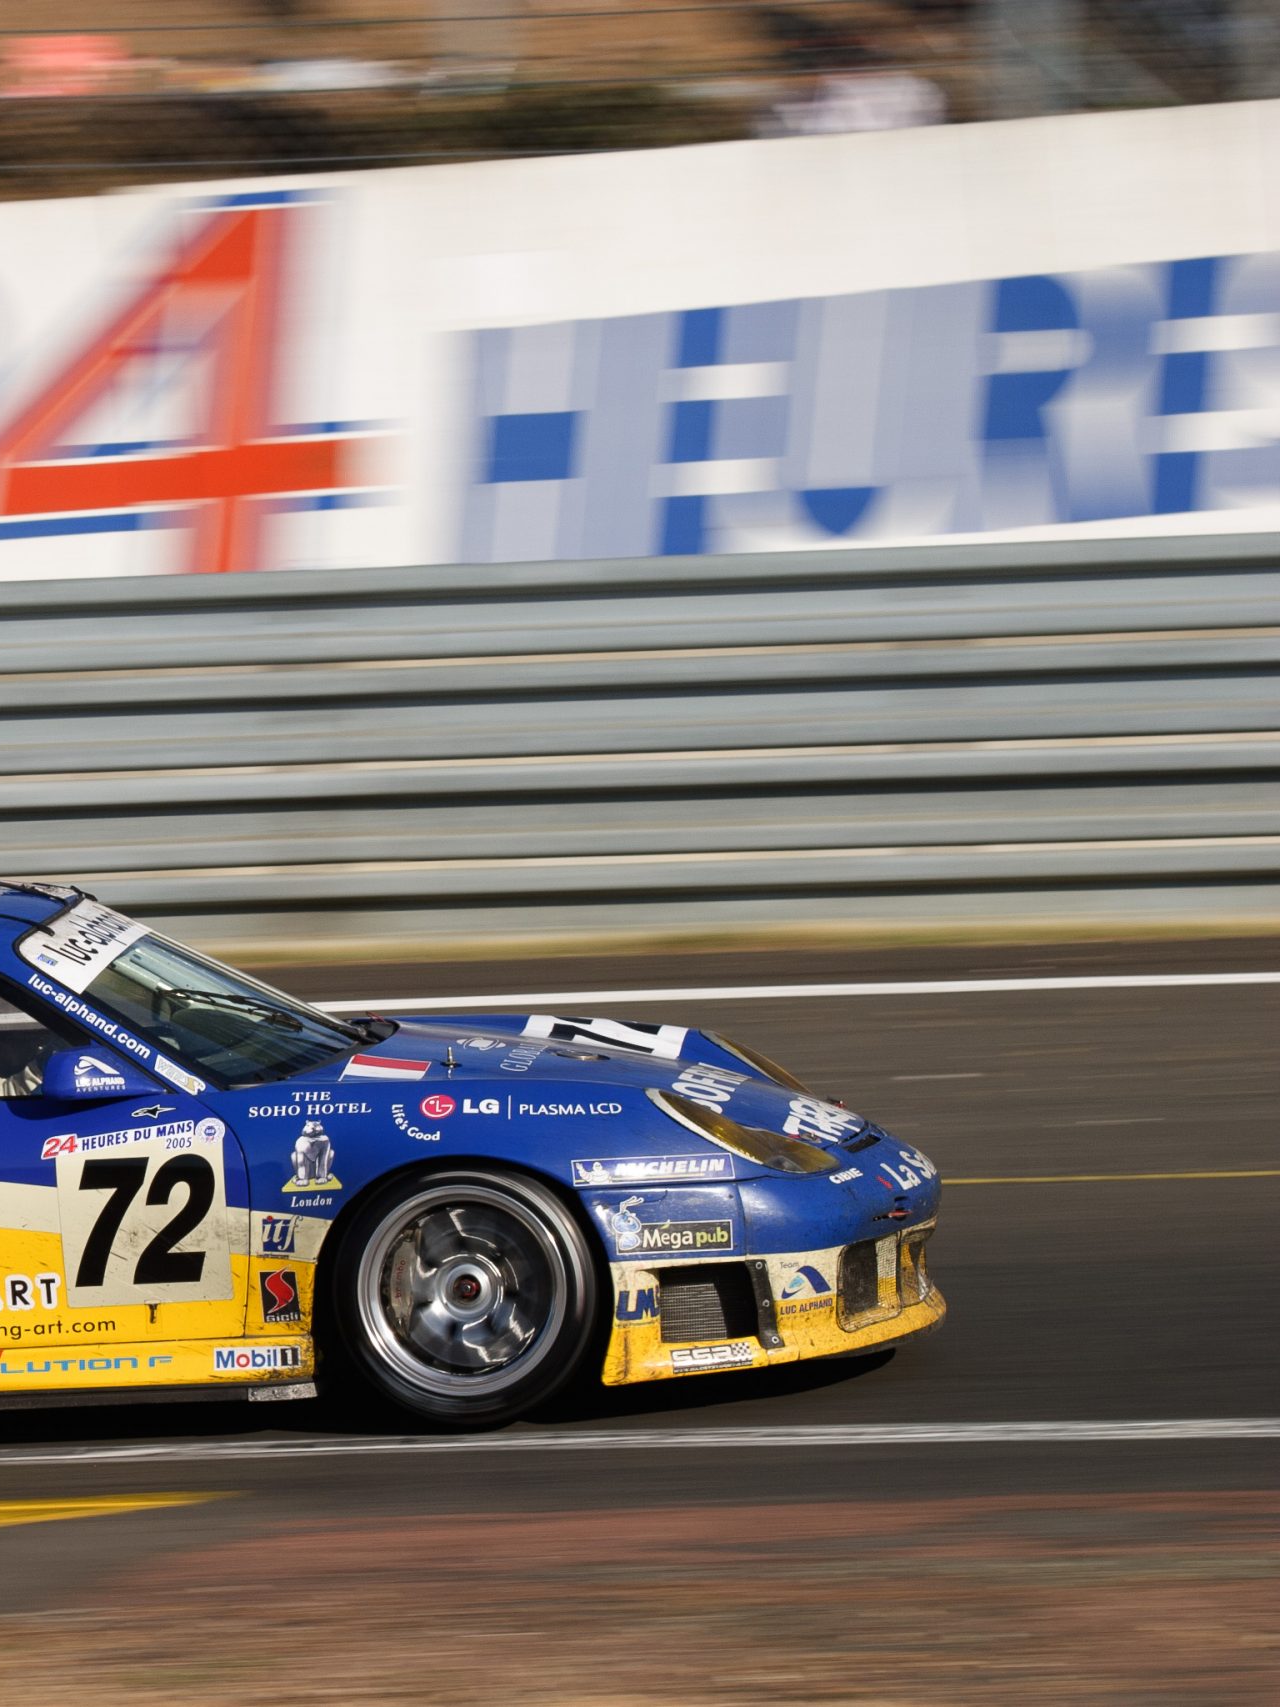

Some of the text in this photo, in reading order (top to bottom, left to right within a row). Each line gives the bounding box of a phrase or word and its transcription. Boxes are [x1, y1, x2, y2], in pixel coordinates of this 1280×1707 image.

[28, 973, 151, 1059] luc-alphand.com
[291, 1091, 332, 1102] THE
[248, 1103, 372, 1118] SOHO HOTEL
[462, 1098, 500, 1114] LG
[519, 1102, 623, 1116] PLASMA LCD
[43, 1135, 78, 1158] 24
[82, 1131, 129, 1152] HEURES
[134, 1127, 152, 1140] DU
[156, 1121, 193, 1138] MANS
[407, 1126, 441, 1141] Good
[165, 1137, 193, 1150] 2005
[615, 1158, 725, 1177] MICHELIN
[290, 1195, 333, 1208] London
[75, 1153, 216, 1287] 72
[780, 1304, 797, 1316] LUC
[149, 1355, 173, 1368] F
